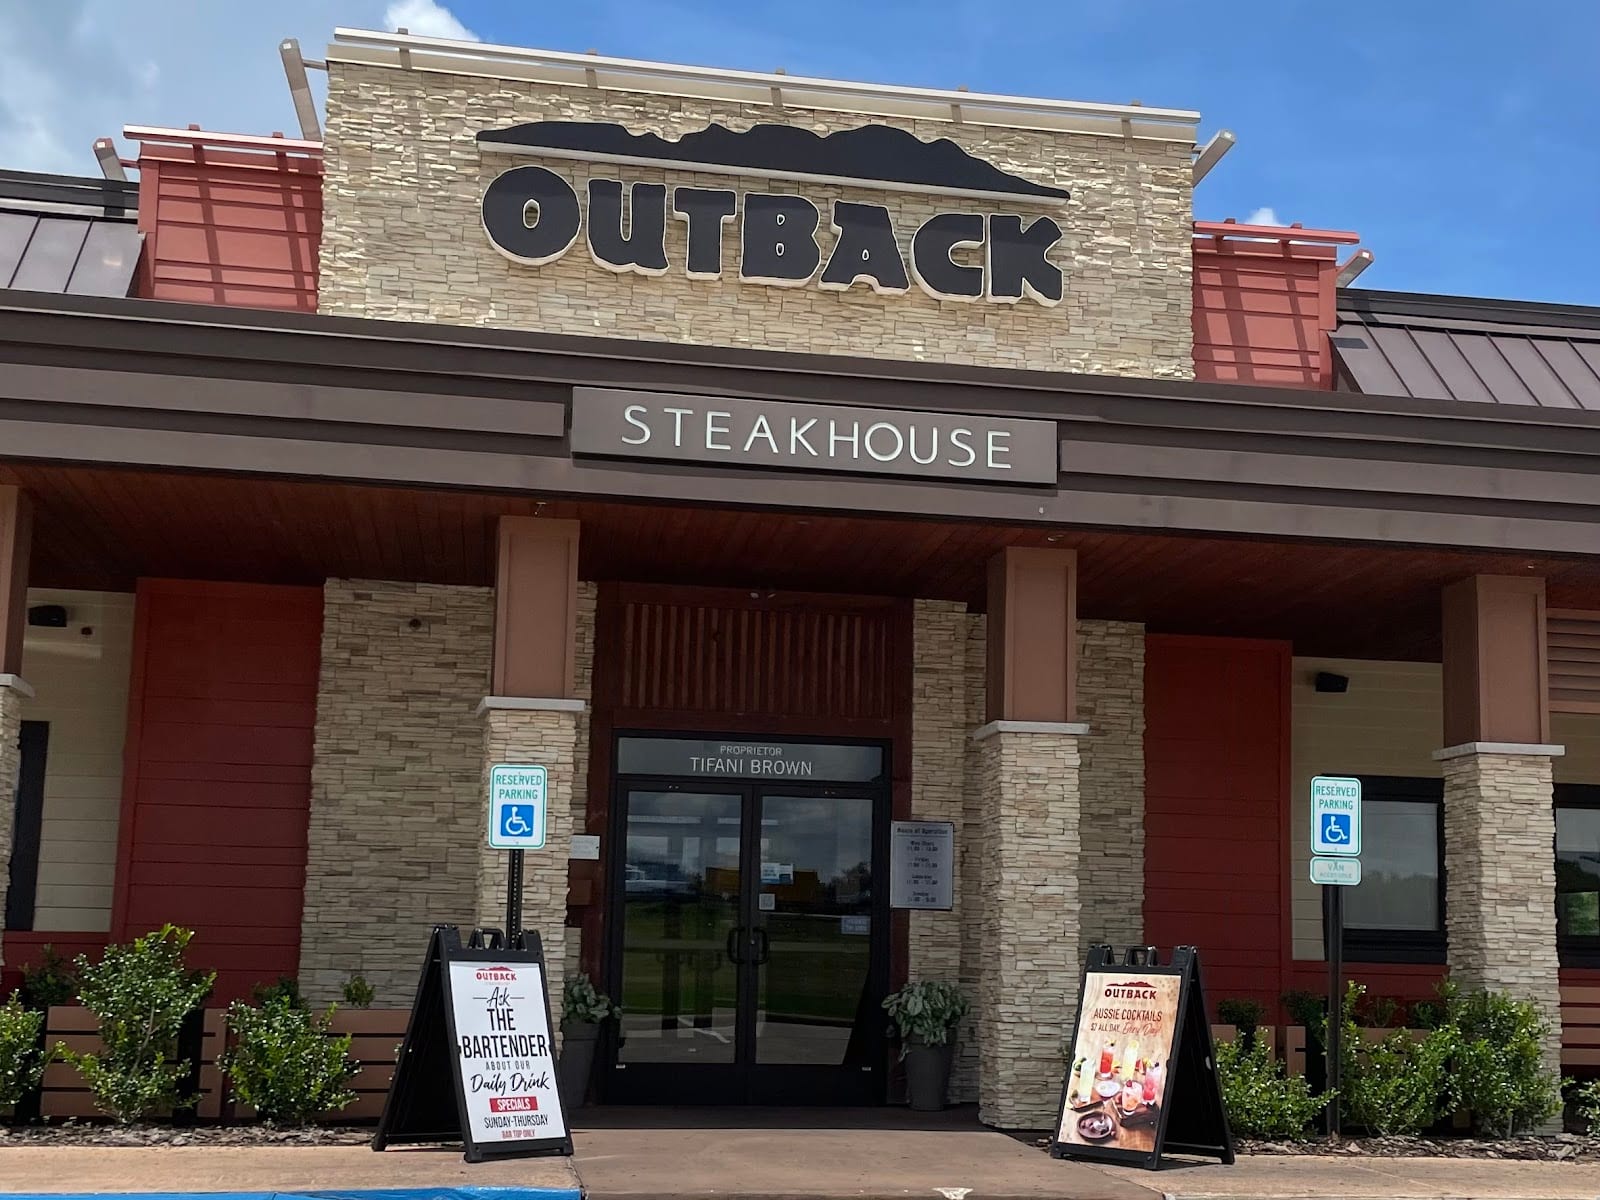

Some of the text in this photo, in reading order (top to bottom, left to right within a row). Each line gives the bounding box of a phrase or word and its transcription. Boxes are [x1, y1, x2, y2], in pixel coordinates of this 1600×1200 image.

[481, 165, 1064, 307] OUTBACK
[620, 404, 1012, 470] STEAKHOUSE
[720, 745, 783, 756] PROPRIETOR
[689, 757, 812, 775] TIFANI BROWN
[496, 774, 542, 786] RESERVED
[499, 788, 538, 800] PARKING
[1315, 785, 1357, 797] RESERVED
[1319, 799, 1353, 810] PARKING
[1327, 862, 1345, 871] VAN
[476, 972, 517, 981] OUTBACK
[486, 986, 511, 1009] Ask
[1104, 988, 1157, 1000] OUTBACK
[486, 1008, 517, 1031] THE
[1093, 1008, 1163, 1022] AUSSIE COCKTAILS
[1098, 1022, 1108, 1032] ALL
[461, 1034, 548, 1059] BARTENDER
[486, 1060, 531, 1071] ABOUT OUR
[470, 1071, 550, 1096] Daily Drink
[496, 1098, 531, 1111] SPECIALS
[484, 1114, 549, 1129] SUNDAY-THURSDAY
